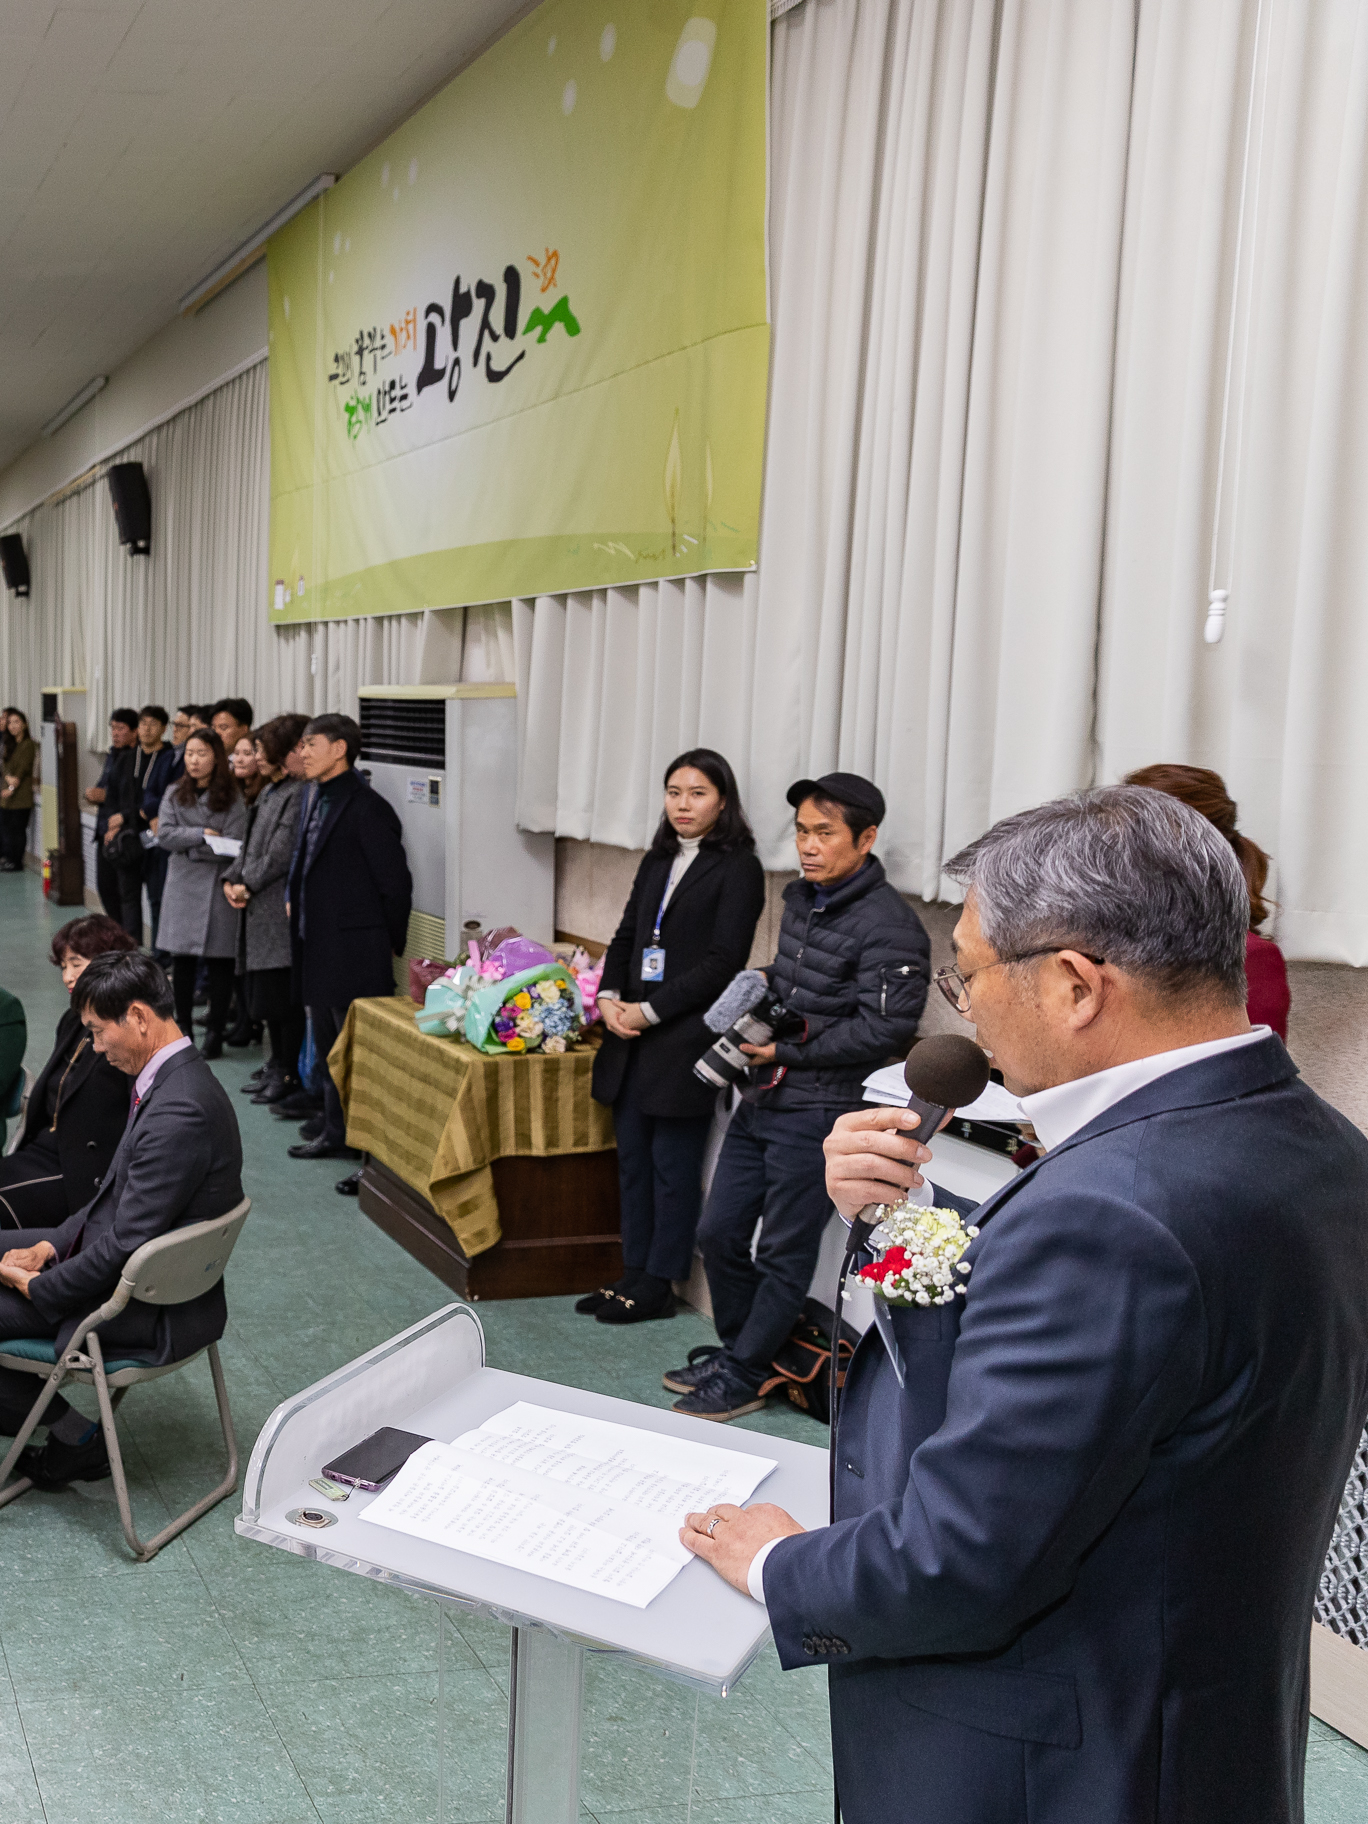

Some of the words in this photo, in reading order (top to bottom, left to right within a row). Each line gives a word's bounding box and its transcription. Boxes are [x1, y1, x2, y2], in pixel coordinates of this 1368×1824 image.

[389, 306, 417, 356] 가치
[417, 265, 525, 403] 광진
[344, 388, 373, 440] 함께
[375, 374, 414, 426] 만드는
